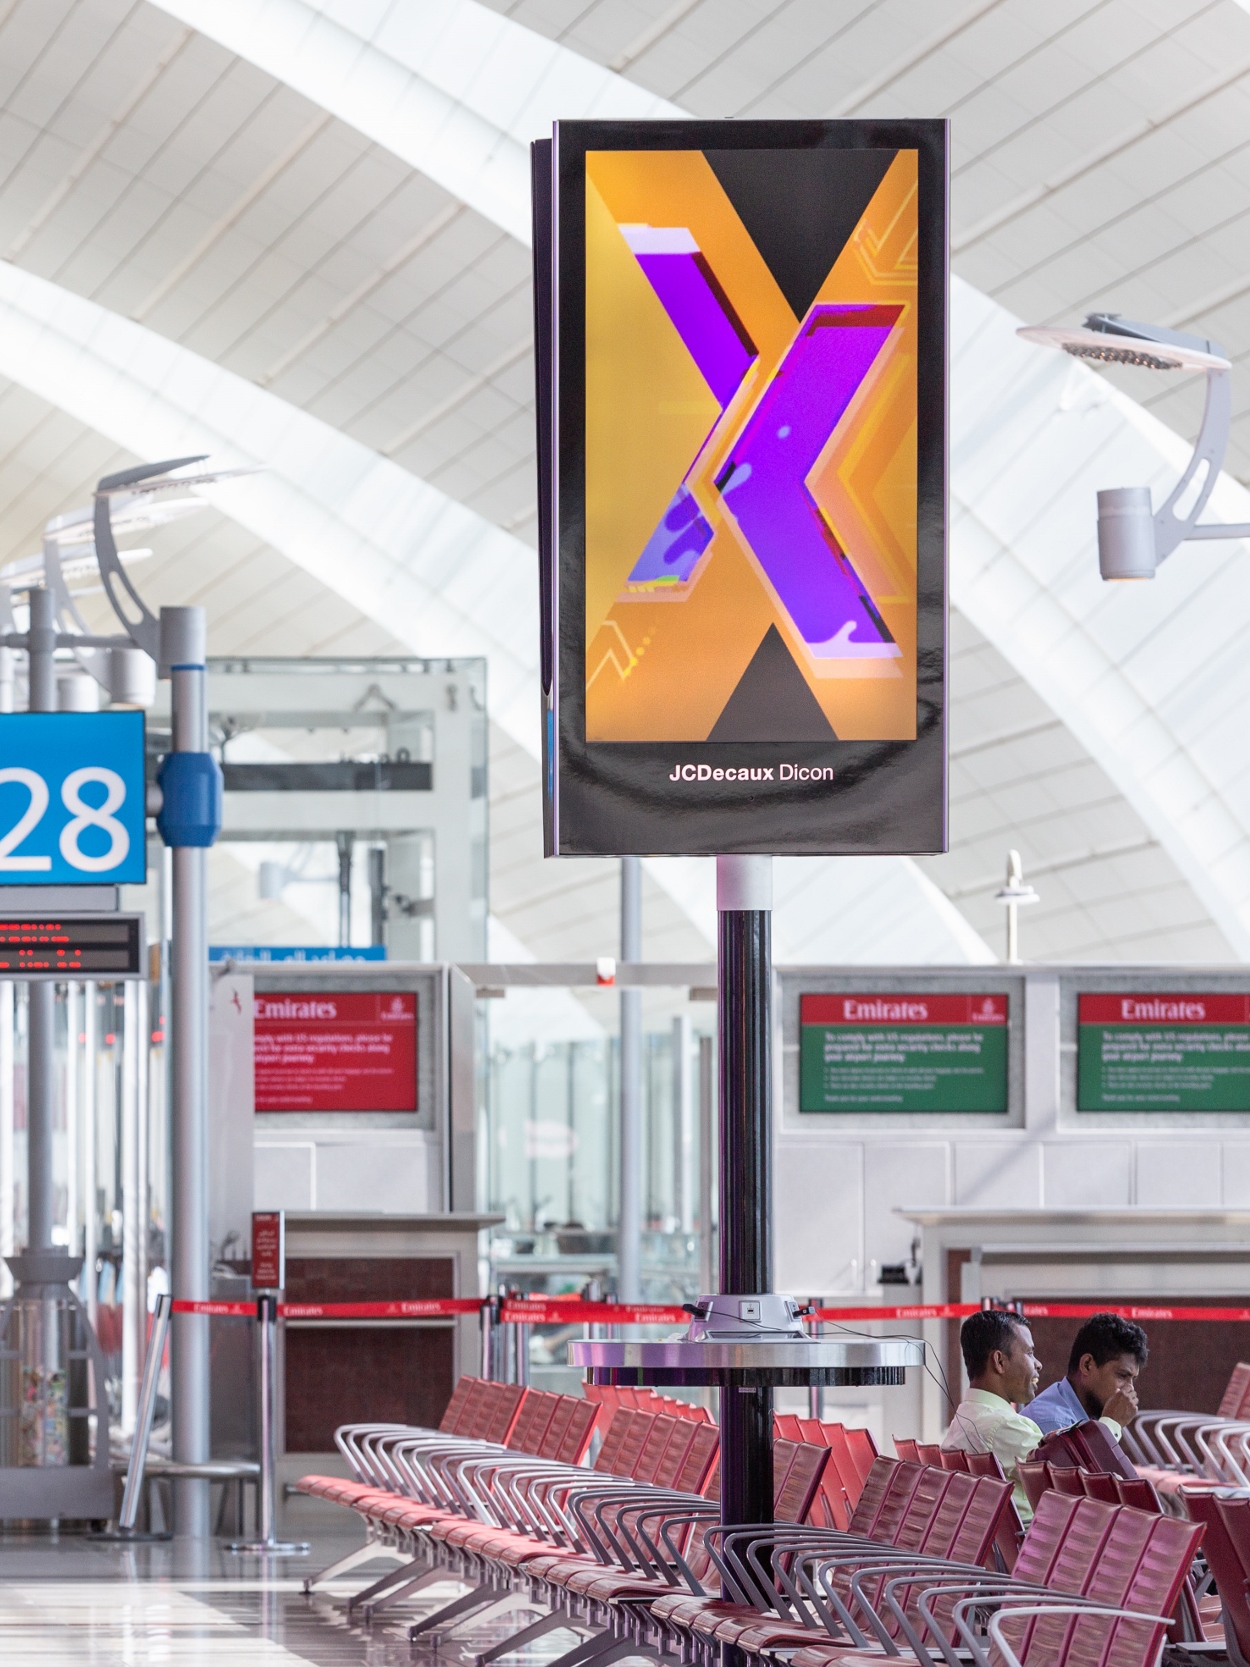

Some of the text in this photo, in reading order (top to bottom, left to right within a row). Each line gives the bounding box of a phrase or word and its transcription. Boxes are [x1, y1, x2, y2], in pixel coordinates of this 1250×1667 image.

[669, 763, 834, 781] JCDecaux Dicon
[254, 999, 337, 1020] Emirates
[843, 999, 929, 1020] Emirates
[1121, 998, 1206, 1020] Emirates
[283, 1305, 323, 1316] Emirates
[400, 1302, 440, 1312] Emirates
[896, 1307, 937, 1318] Emirates
[635, 1312, 676, 1322] Emirates
[1131, 1308, 1172, 1318] Emirates
